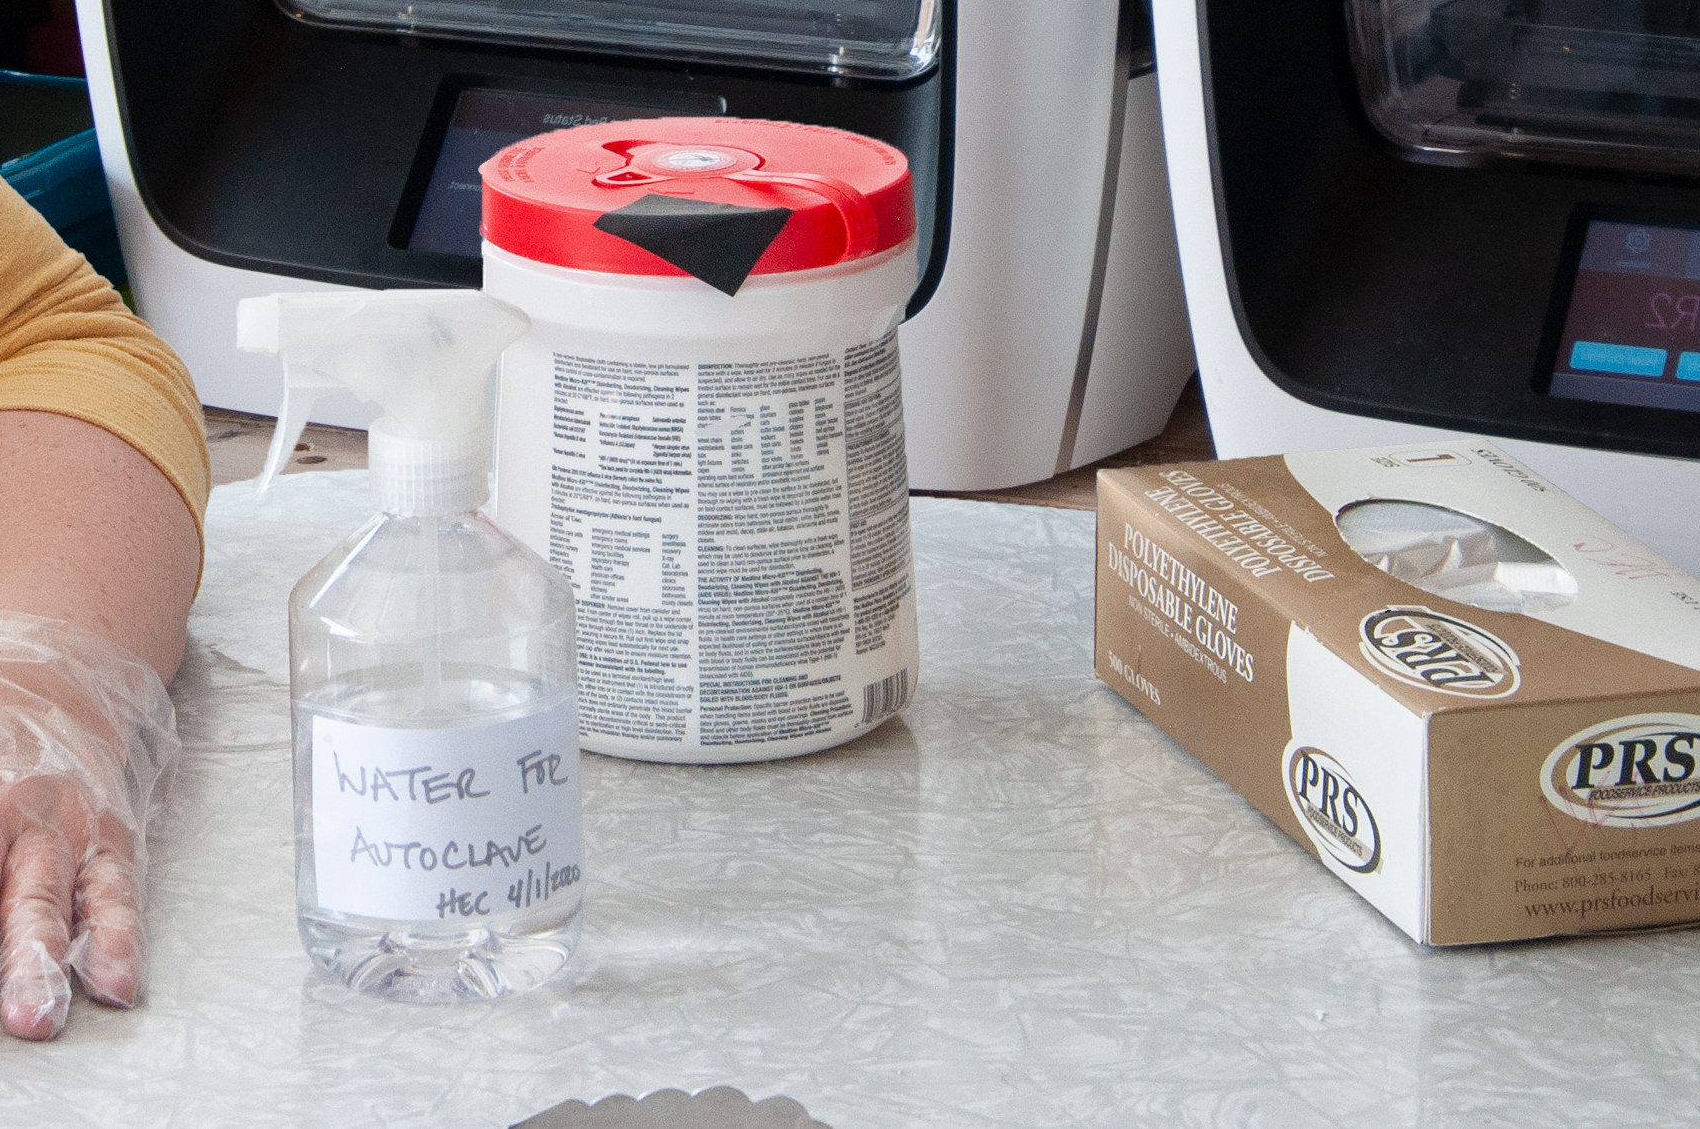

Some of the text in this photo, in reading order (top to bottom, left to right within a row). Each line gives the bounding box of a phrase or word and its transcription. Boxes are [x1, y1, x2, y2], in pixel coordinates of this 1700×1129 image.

[1471, 449, 1528, 479] GLOVES
[1145, 486, 1282, 578] POLYETHYLENE
[1159, 470, 1335, 582] DISPOSABLE GLOVES
[1124, 523, 1239, 634] POLYETHYLENE
[1108, 541, 1254, 683] DISPOSABLE GLOVES
[1142, 606, 1170, 638] STERILE
[1174, 633, 1227, 684] AMBIDEXTROUS
[1379, 631, 1495, 687] PRS
[773, 675, 796, 683] CLEANING
[1124, 663, 1161, 706] GLOVES
[334, 749, 568, 805] WATER FOR
[1571, 734, 1696, 789] PRS
[1299, 750, 1359, 837] PRS
[1589, 785, 1651, 801] FOODSERVICE
[350, 824, 547, 871] AUTOCLAVE
[1516, 857, 1535, 868] For
[1539, 851, 1596, 867] additional
[1599, 848, 1666, 861] foodservice
[436, 888, 490, 918] HEC
[1515, 879, 1558, 893] Phone:
[1562, 871, 1651, 889] 800-285-8165
